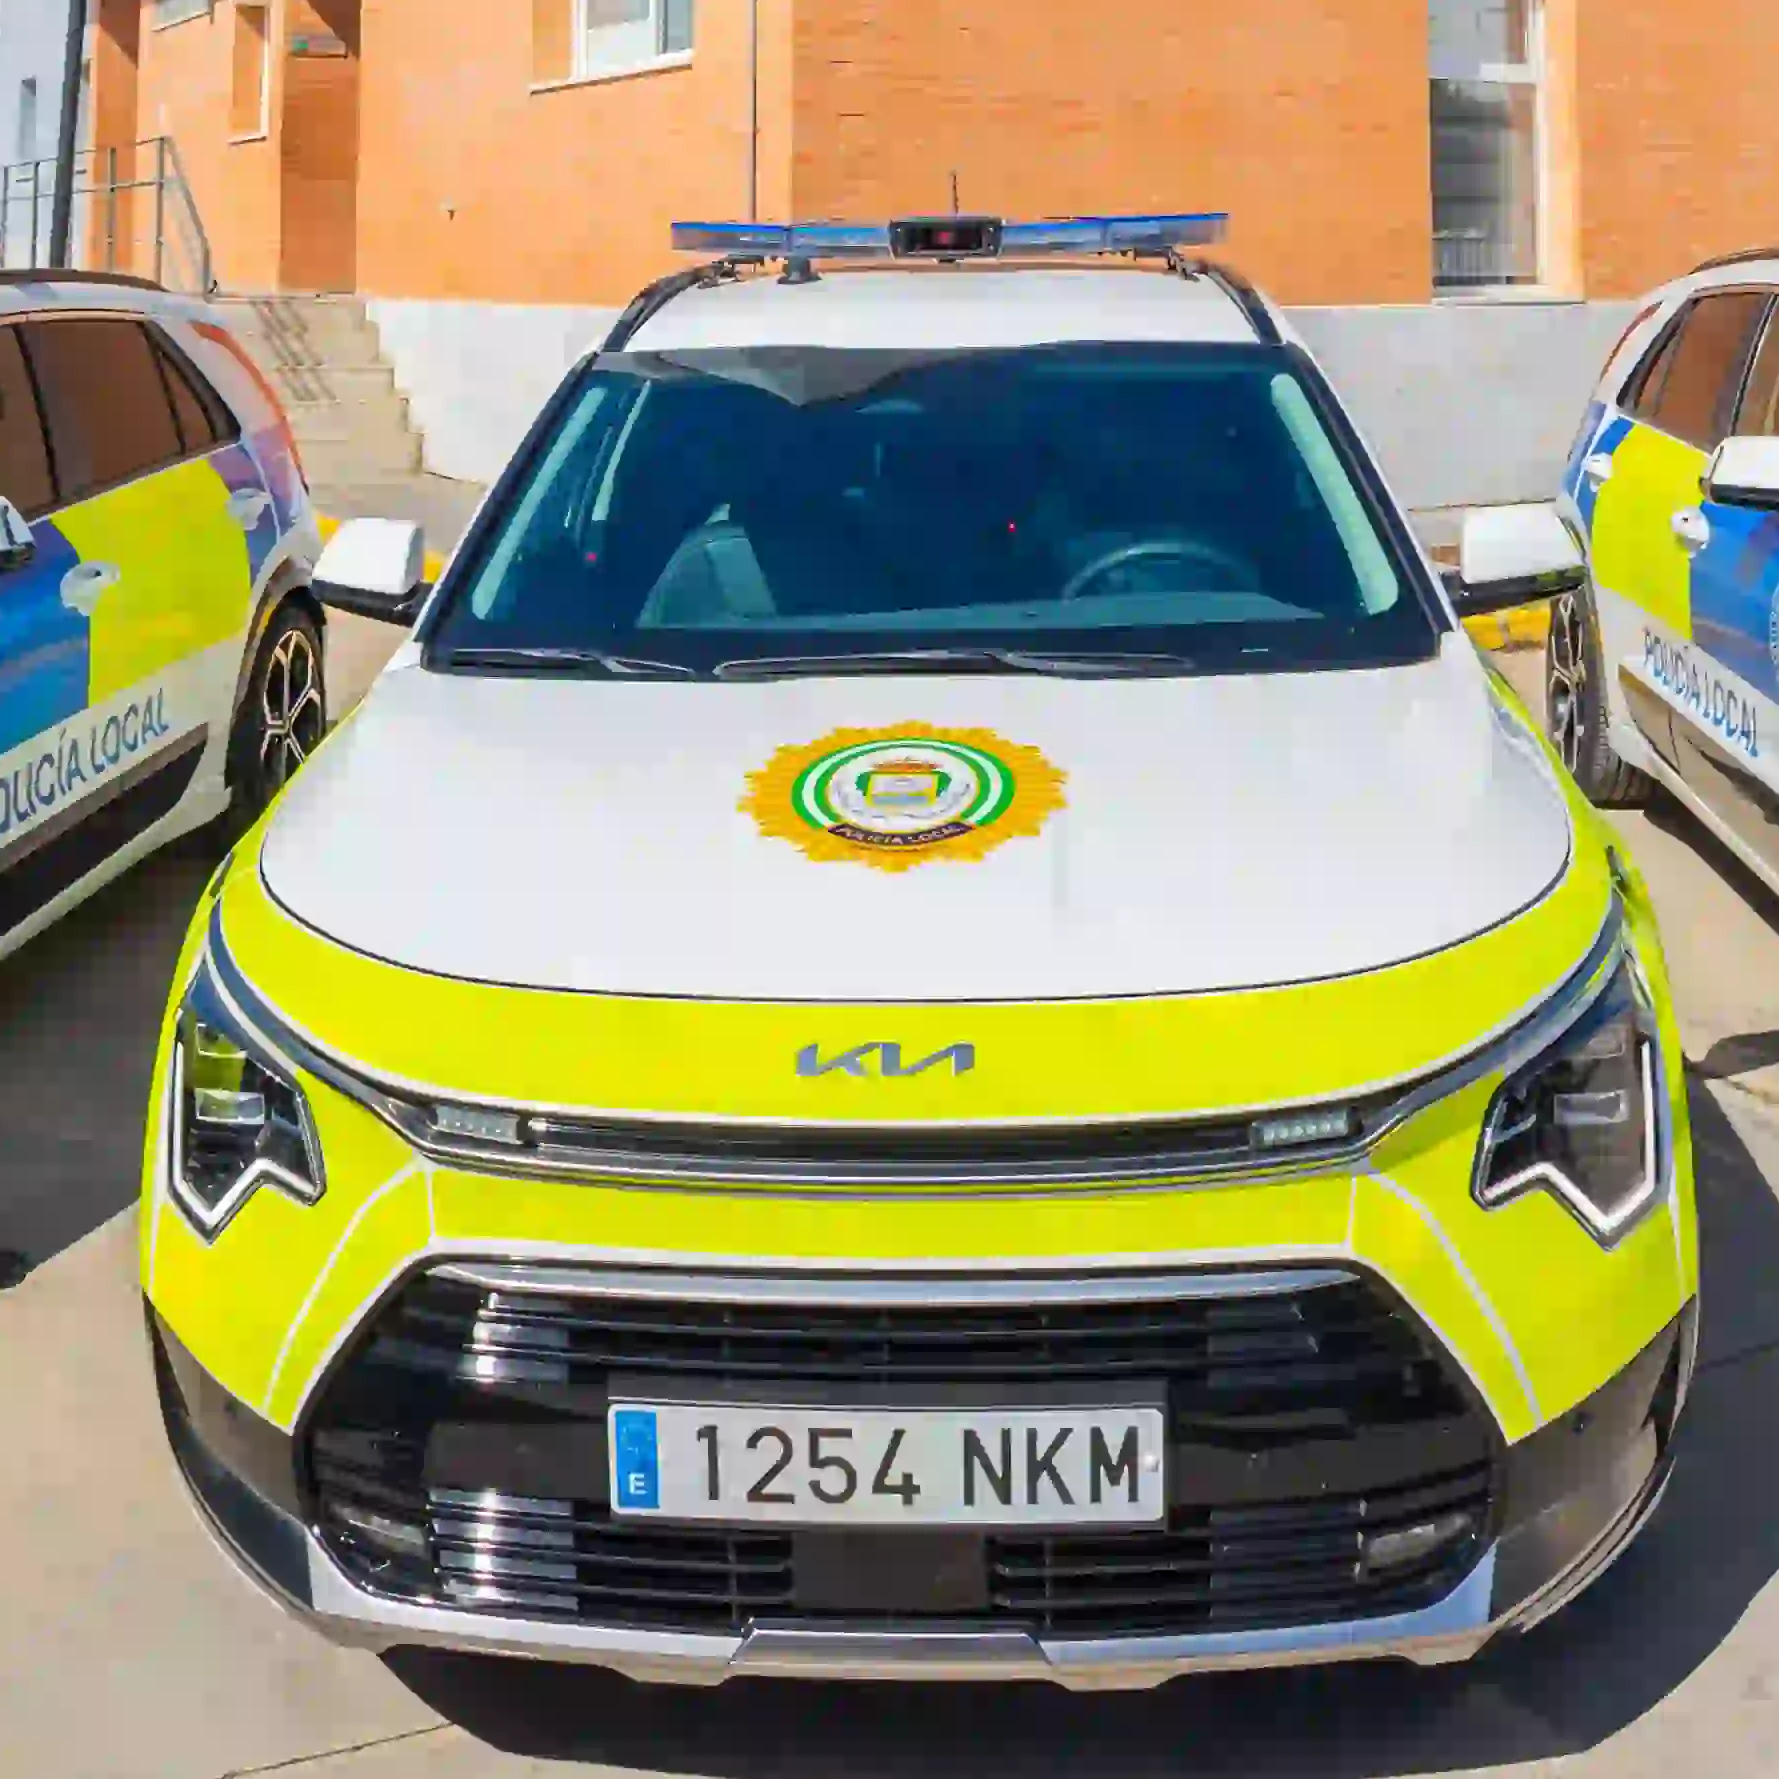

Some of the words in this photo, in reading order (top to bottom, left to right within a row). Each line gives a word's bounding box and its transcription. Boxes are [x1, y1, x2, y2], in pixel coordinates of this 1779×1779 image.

[89, 686, 170, 774] LOCAL
[1702, 669, 1759, 758] LOCAL
[795, 1041, 976, 1077] KIA
[627, 1472, 648, 1495] E
[694, 1423, 922, 1506] 1254
[962, 1424, 1140, 1506] NKM
